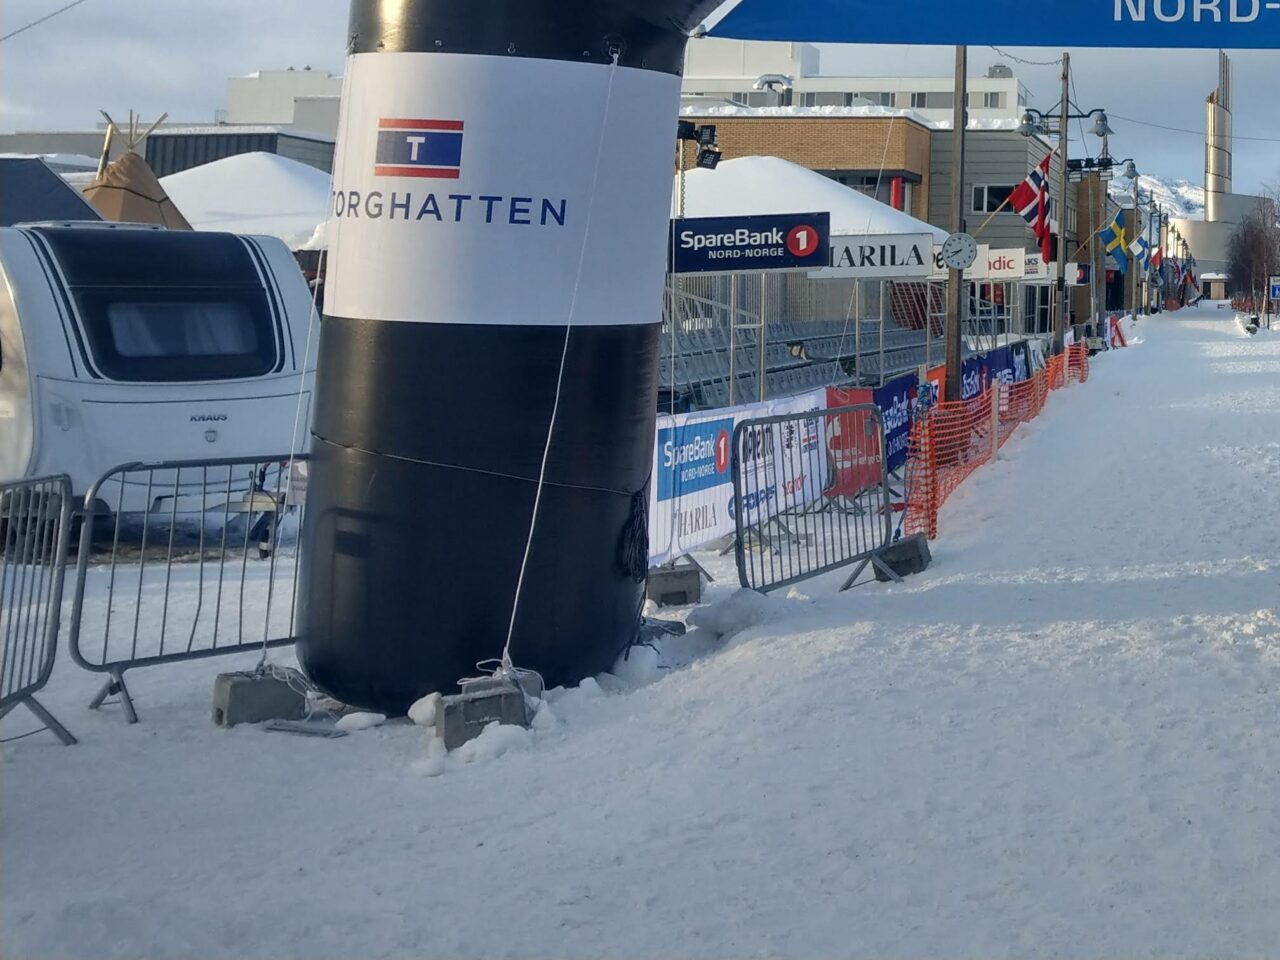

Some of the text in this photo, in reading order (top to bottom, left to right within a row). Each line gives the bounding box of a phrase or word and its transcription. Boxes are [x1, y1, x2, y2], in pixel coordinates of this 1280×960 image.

[680, 227, 808, 251] SpareBank 1
[708, 247, 784, 259] NORD-NORGE
[664, 435, 715, 471] SpareBank
